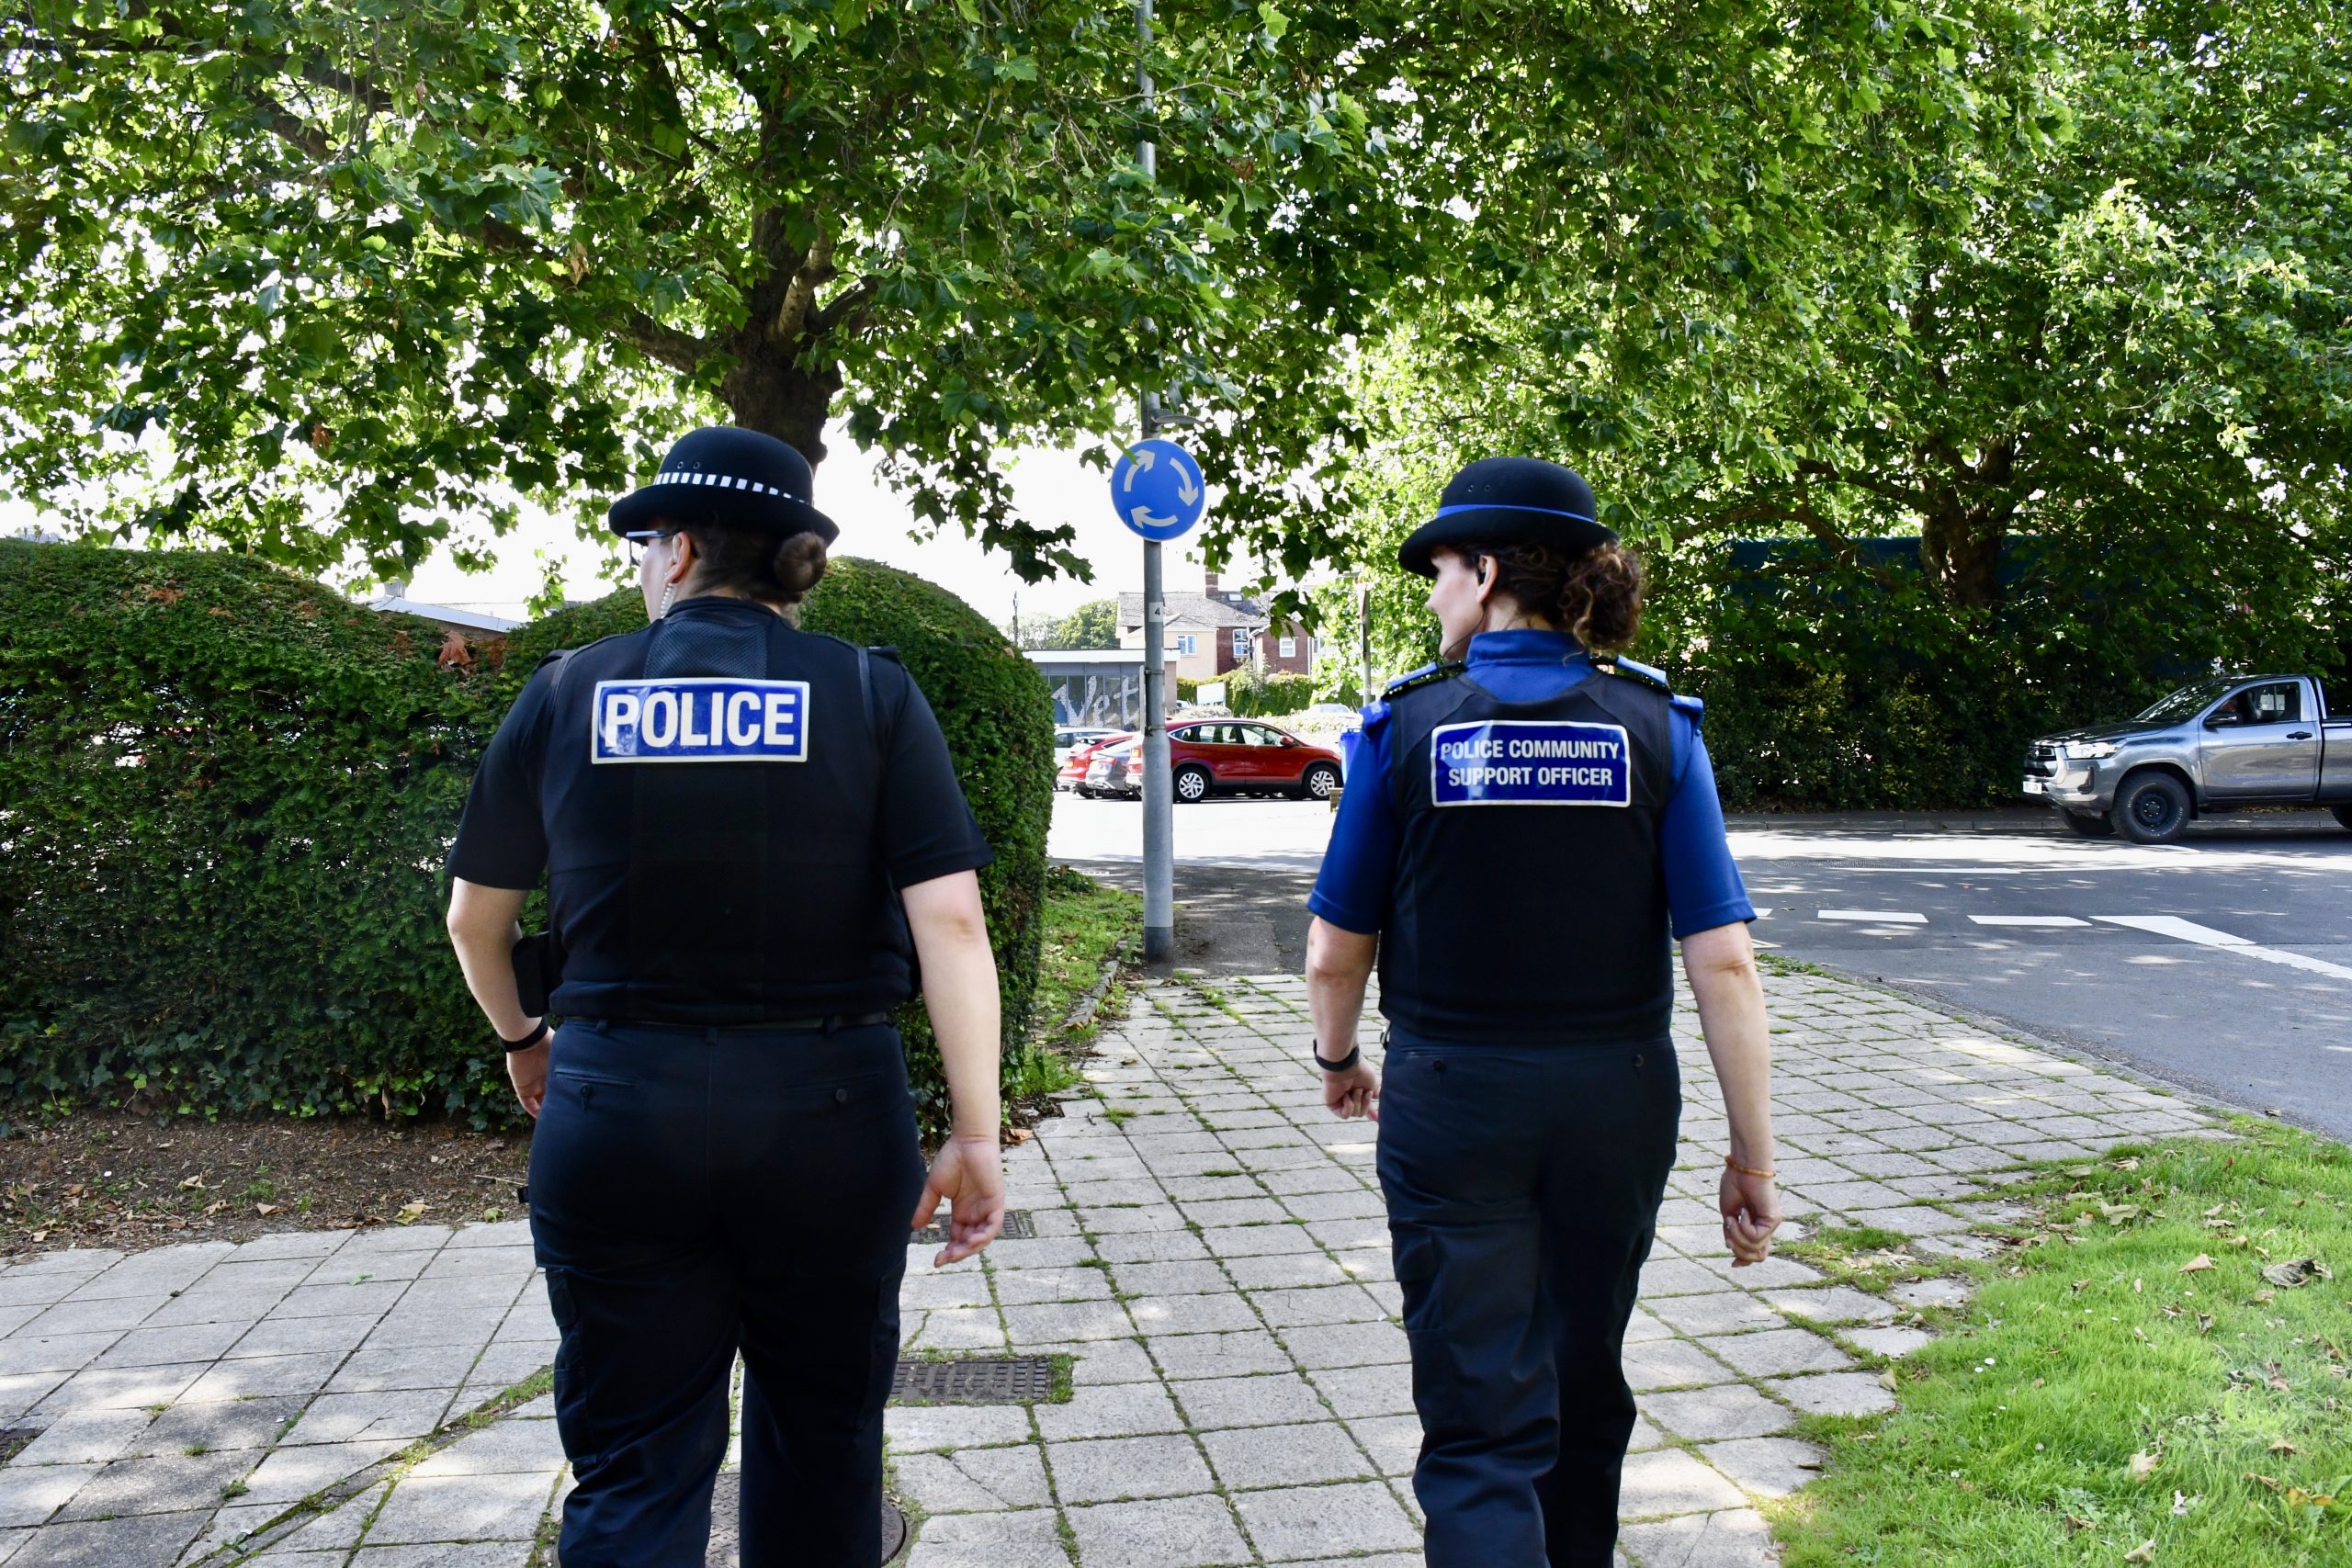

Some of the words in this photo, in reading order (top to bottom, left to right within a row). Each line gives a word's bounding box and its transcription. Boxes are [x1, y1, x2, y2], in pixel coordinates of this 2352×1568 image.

[1154, 607, 1160, 616] 4
[605, 691, 796, 748] POLICE
[1441, 739, 1504, 759] POLICE
[1509, 739, 1619, 759] COMMUNITY
[1448, 767, 1532, 785] SUPPORT
[1537, 767, 1613, 785] OFFICER
